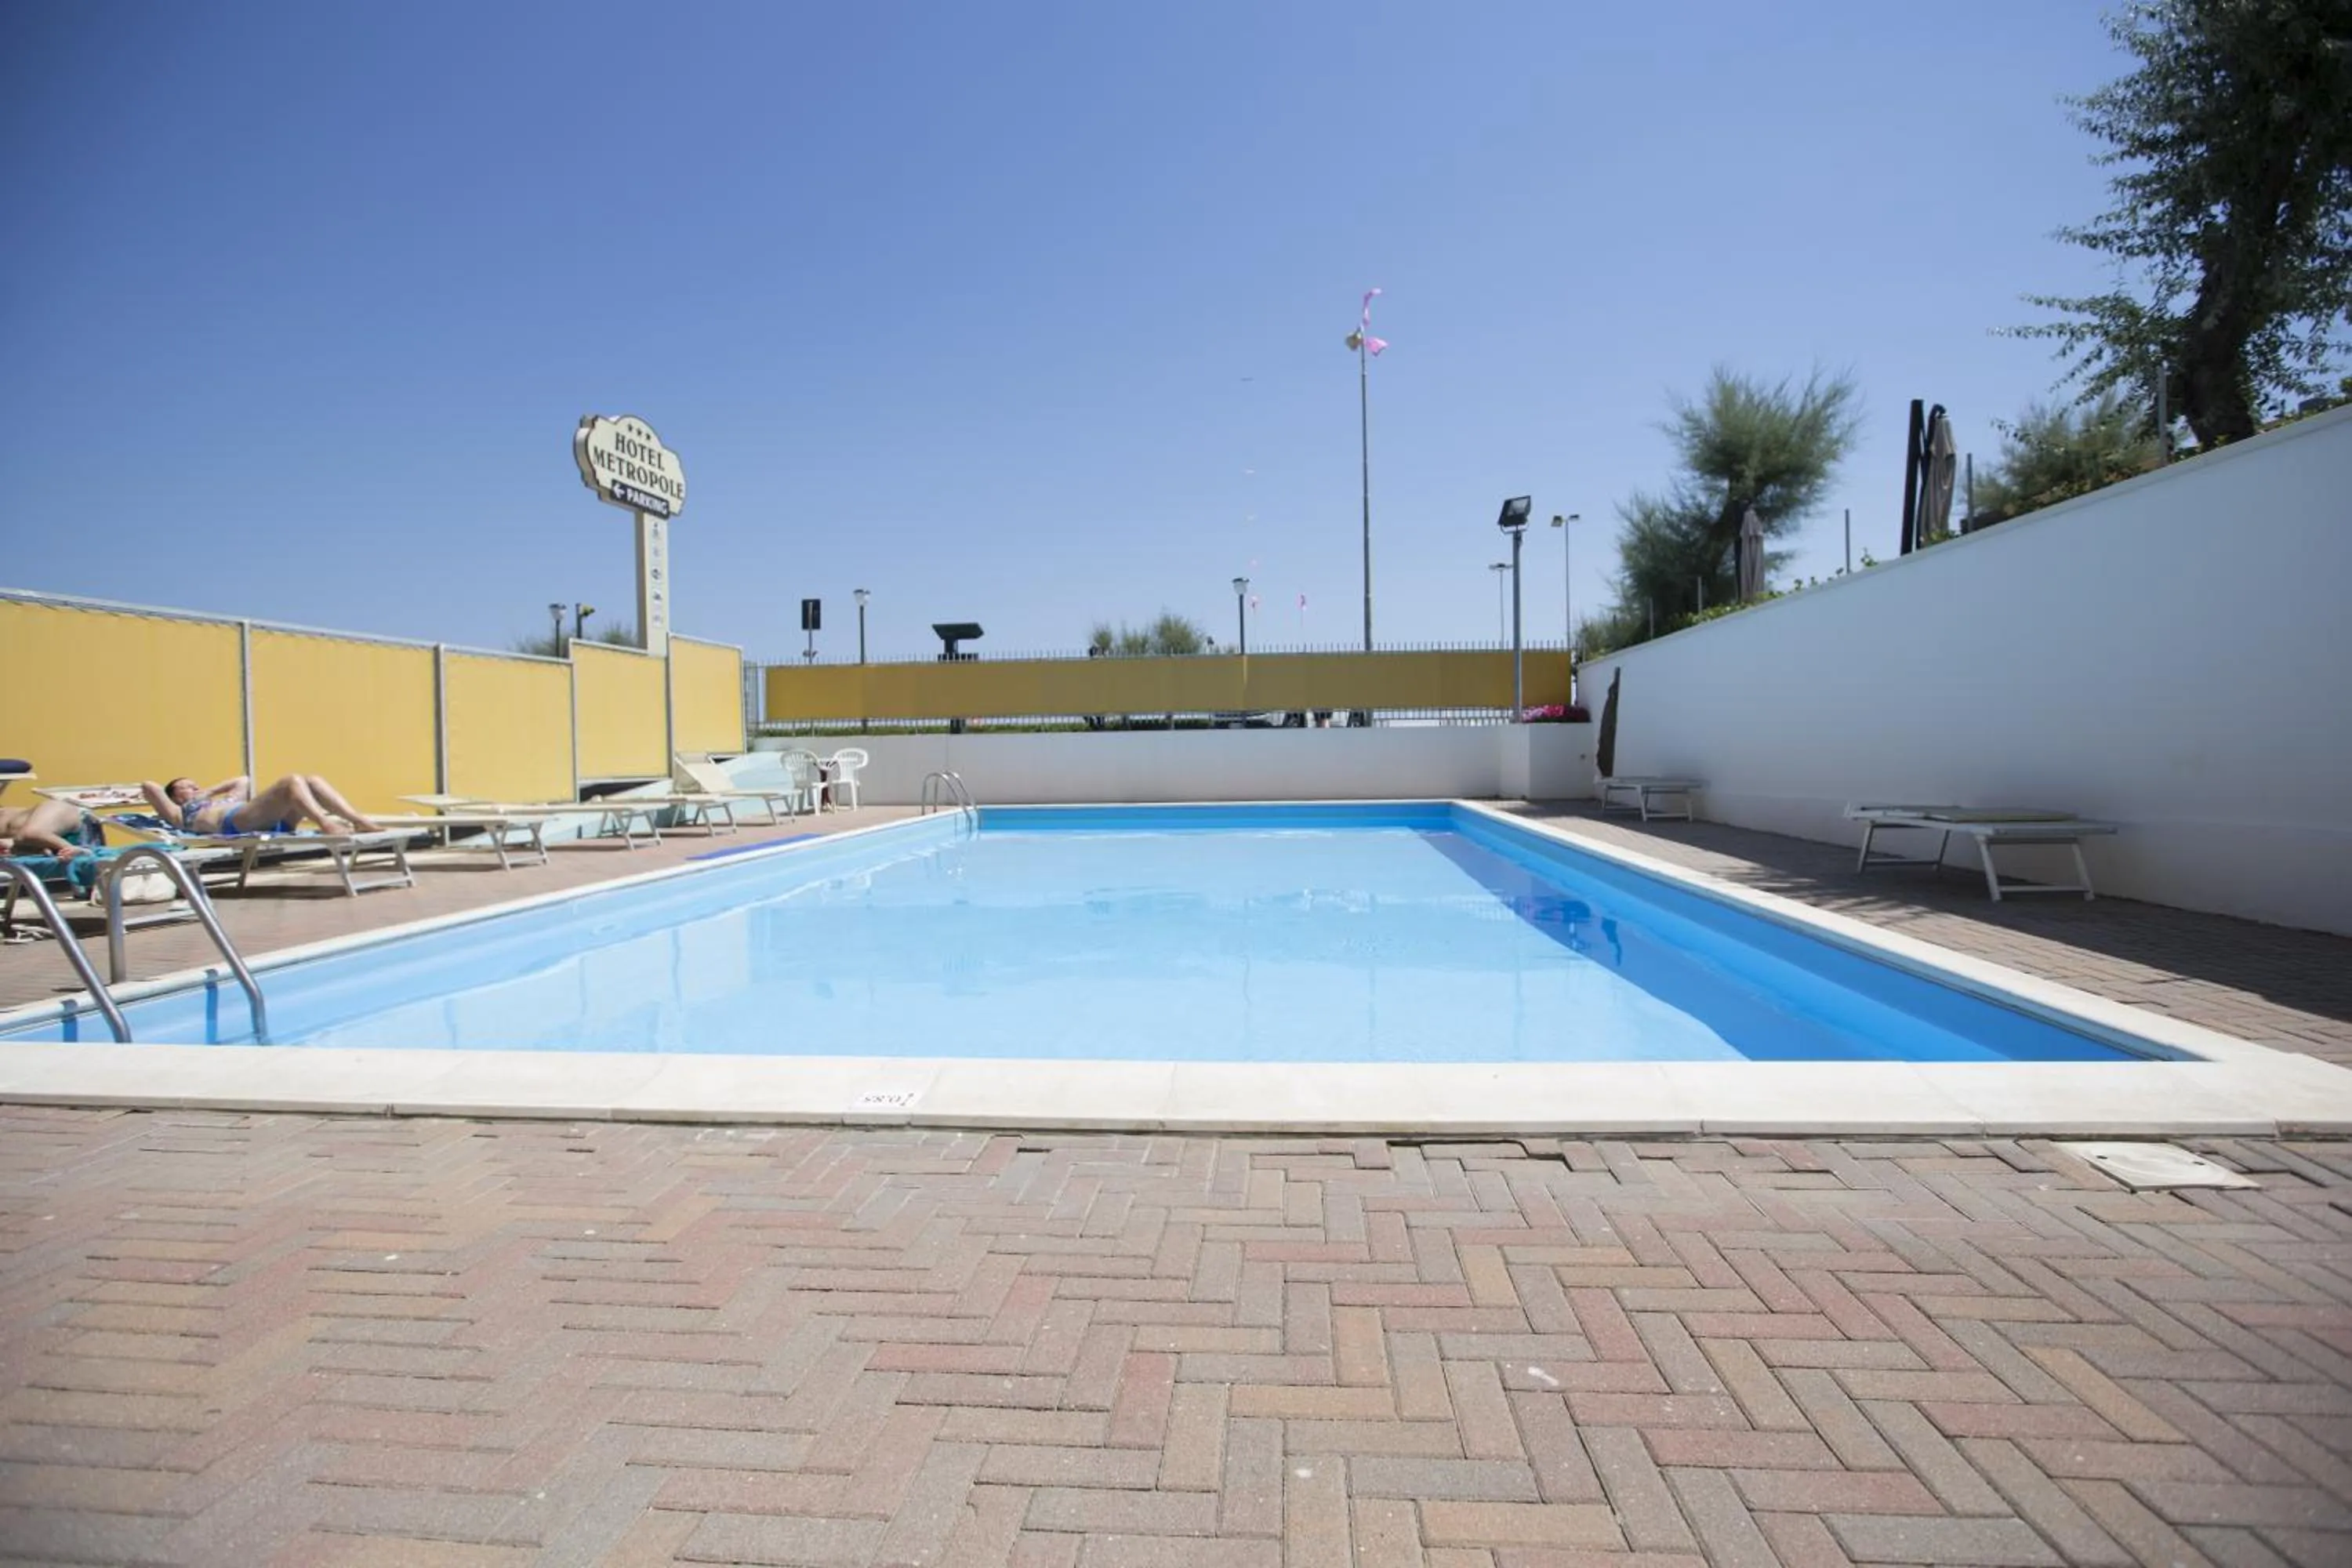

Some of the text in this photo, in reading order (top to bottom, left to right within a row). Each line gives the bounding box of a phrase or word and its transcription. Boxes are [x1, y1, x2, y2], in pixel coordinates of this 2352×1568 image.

[615, 432, 665, 471] HOTEL
[593, 446, 684, 499] METROPOLE
[626, 488, 666, 514] PARKING
